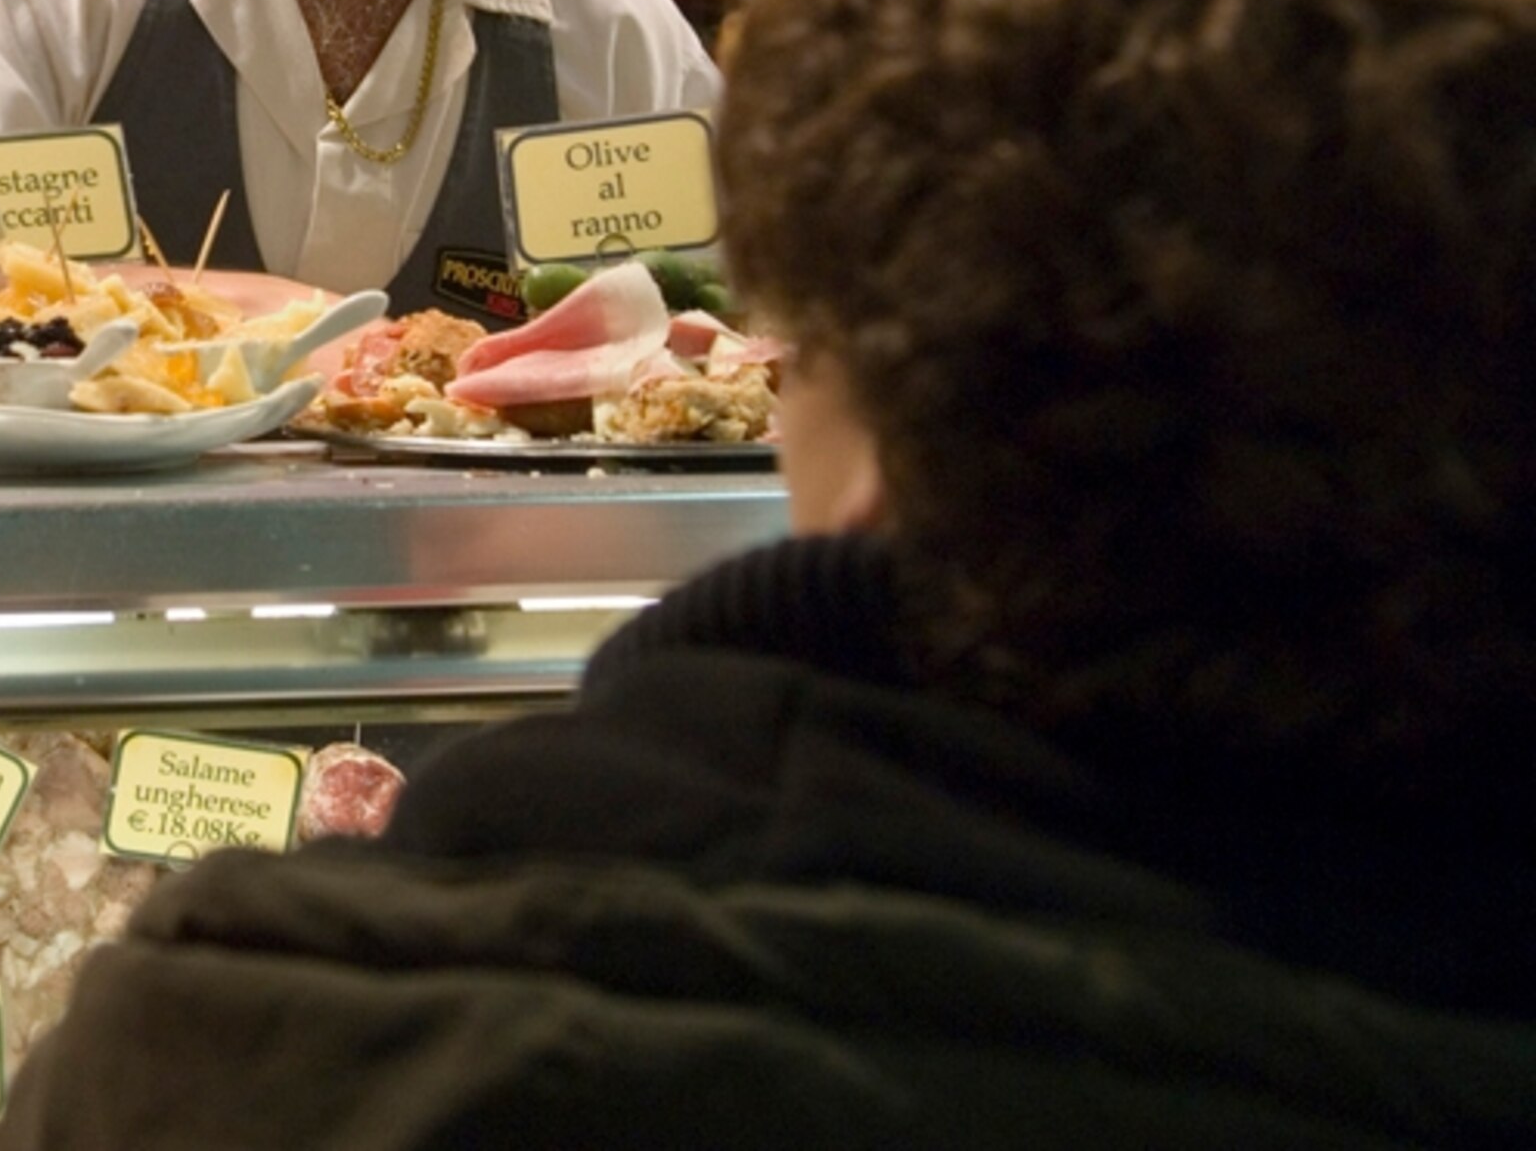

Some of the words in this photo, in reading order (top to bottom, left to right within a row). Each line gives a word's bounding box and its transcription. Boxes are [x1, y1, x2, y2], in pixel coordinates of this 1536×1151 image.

[565, 141, 651, 171] Olive
[598, 172, 626, 201] al
[571, 210, 663, 237] ranno
[158, 750, 256, 787] Salame
[135, 784, 272, 820] ungherese
